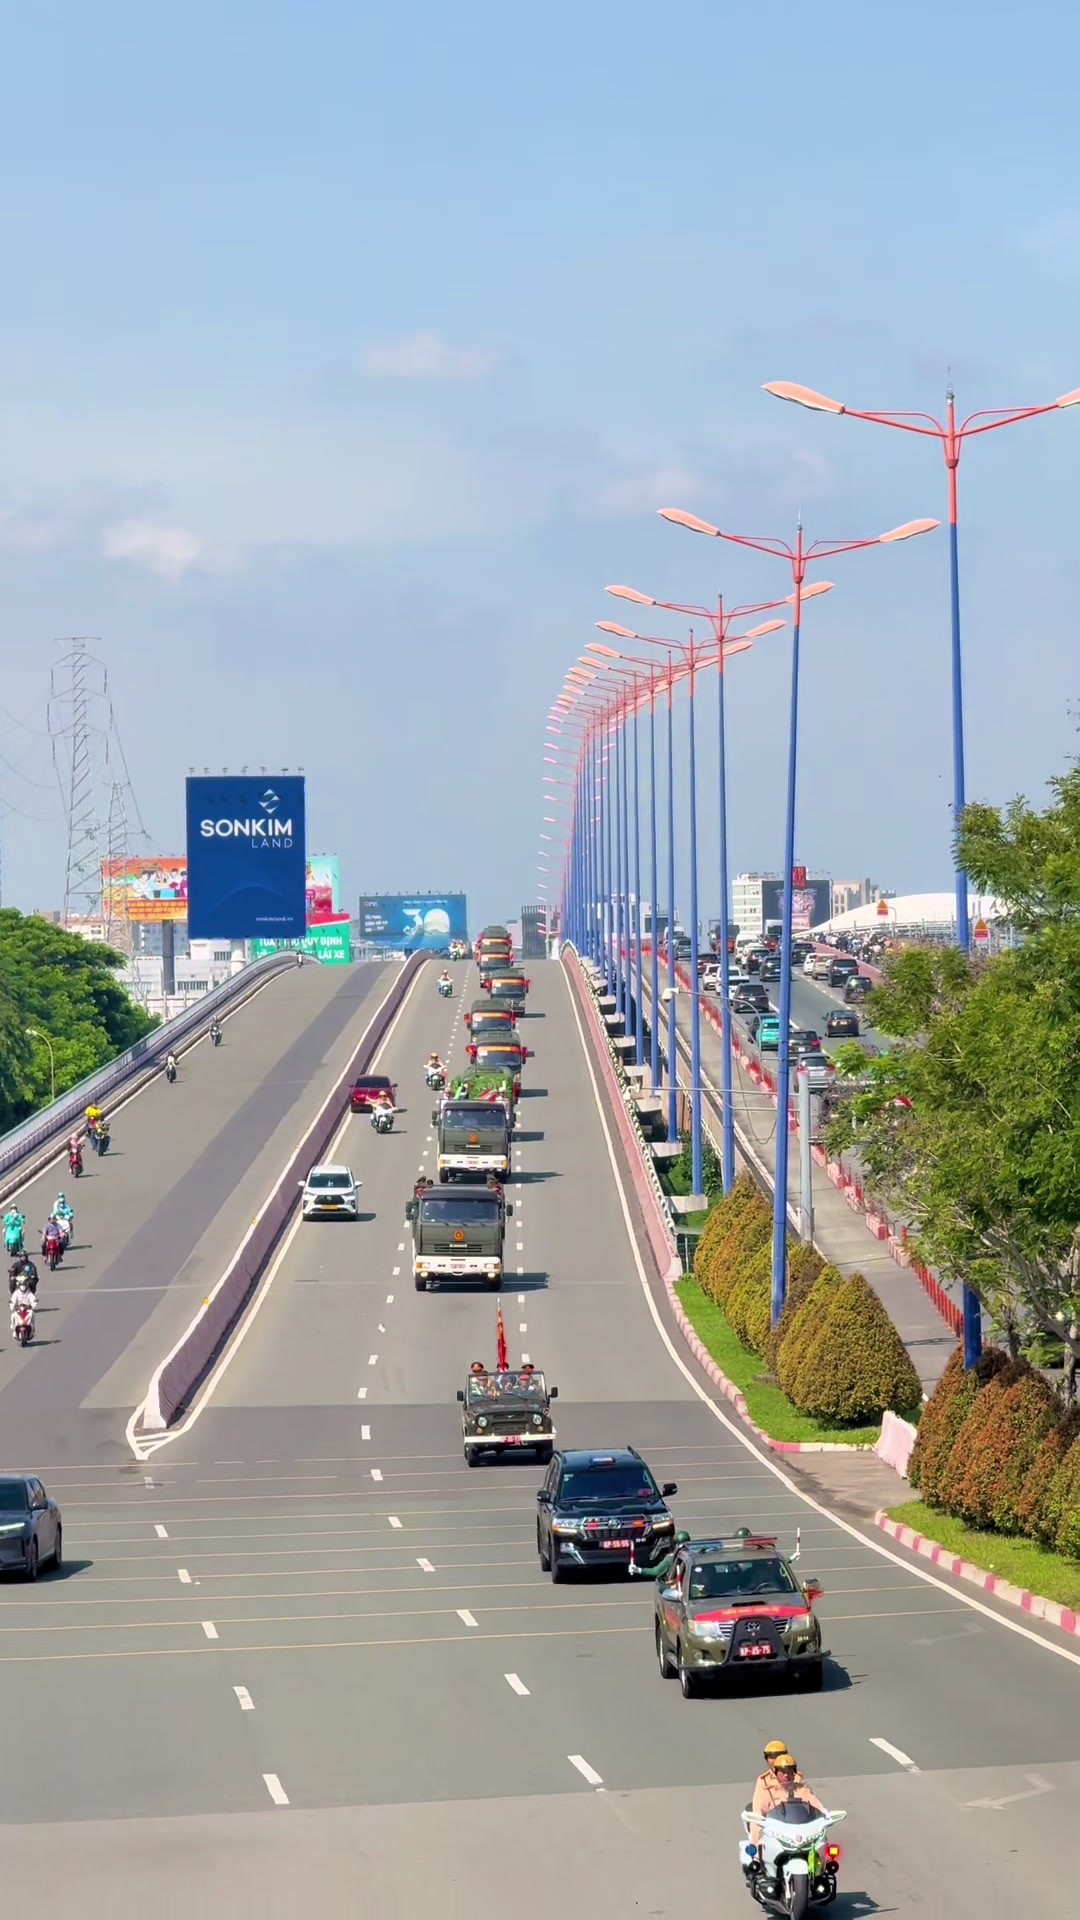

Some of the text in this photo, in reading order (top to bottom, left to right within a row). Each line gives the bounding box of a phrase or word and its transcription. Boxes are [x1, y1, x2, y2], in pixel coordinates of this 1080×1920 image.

[200, 818, 292, 837] SONKIM
[251, 838, 293, 848] LAND
[402, 908, 450, 936] 30
[320, 936, 343, 951] ĐỊNH
[334, 949, 345, 959] XE
